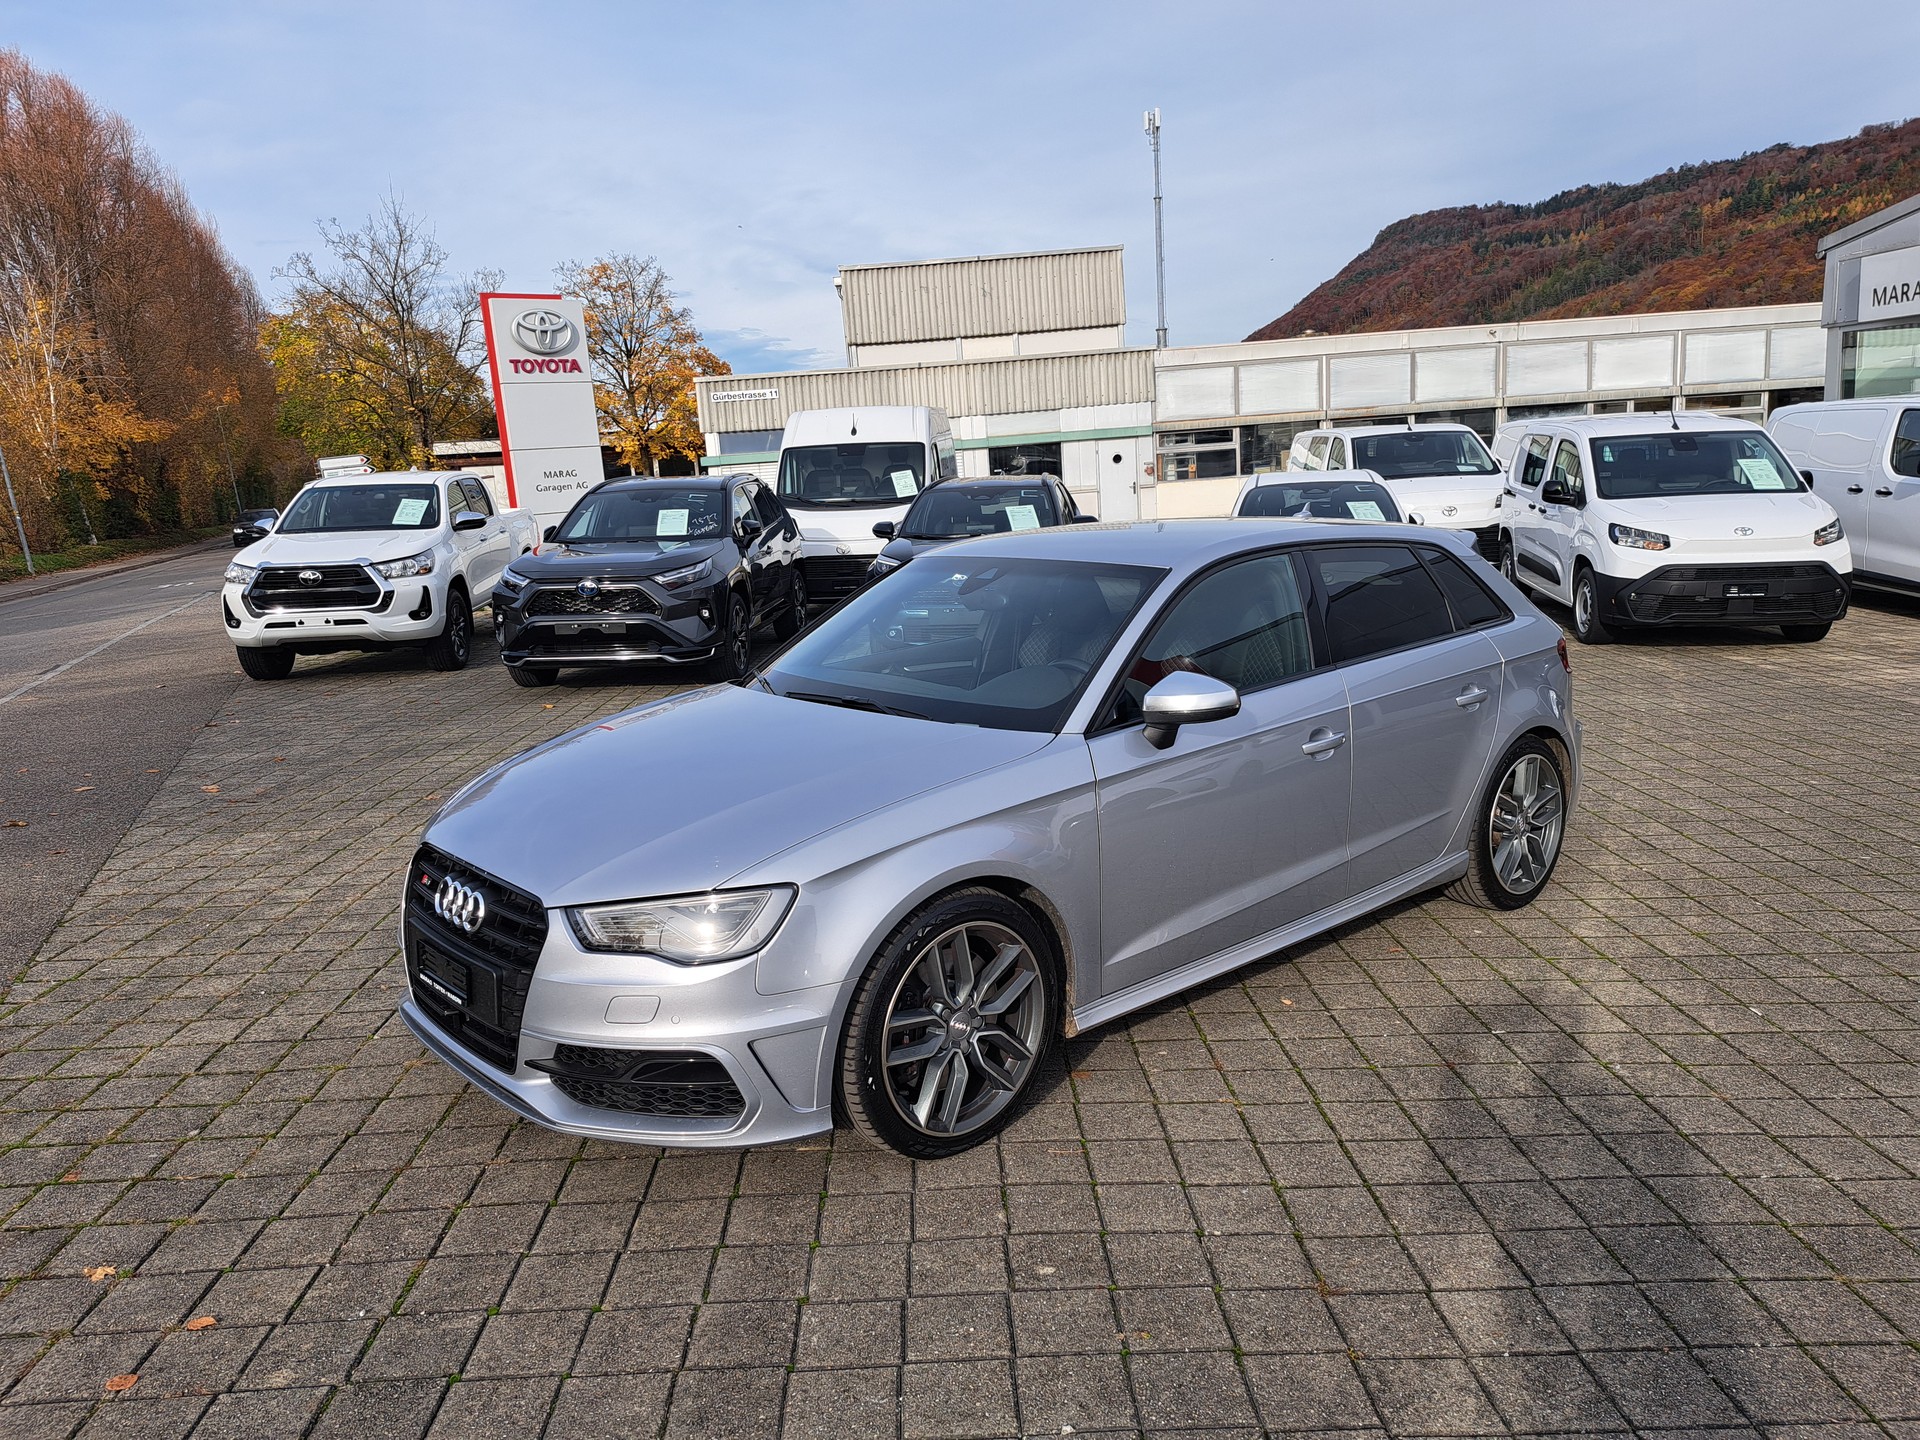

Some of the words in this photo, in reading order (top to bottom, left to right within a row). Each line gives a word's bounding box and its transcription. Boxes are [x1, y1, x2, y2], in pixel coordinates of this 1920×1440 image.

[509, 358, 583, 374] TOYOTA
[712, 392, 767, 401] Gürbestrasse
[543, 469, 578, 479] MARAG
[536, 483, 573, 494] Garagen
[575, 481, 589, 490] AG
